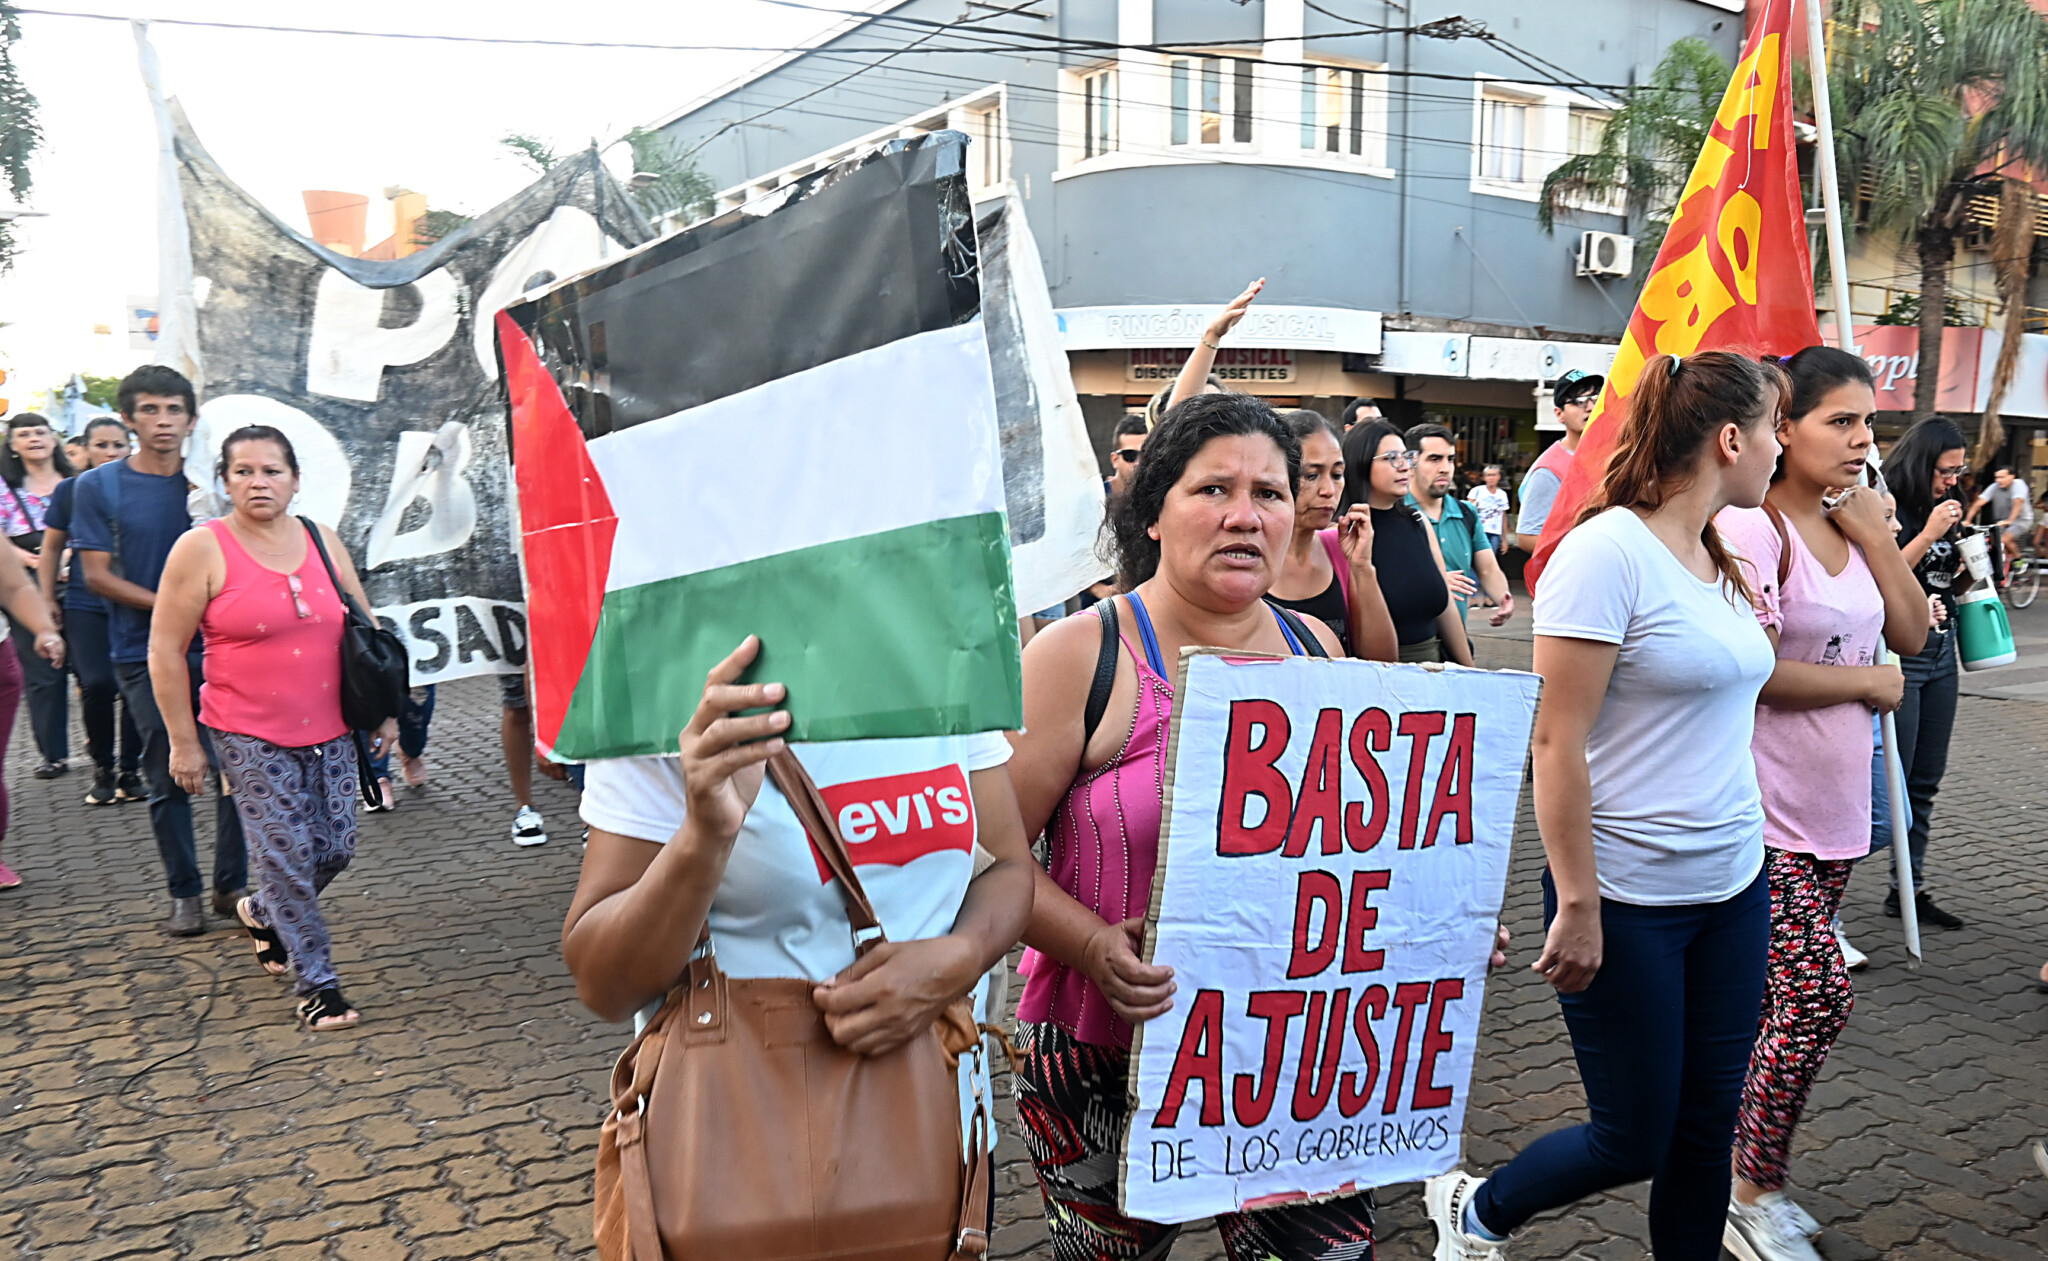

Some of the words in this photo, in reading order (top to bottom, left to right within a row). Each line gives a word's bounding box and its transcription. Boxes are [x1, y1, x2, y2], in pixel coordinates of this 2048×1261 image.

[1107, 309, 1204, 337] RINCÓN
[1233, 313, 1335, 339] USICAL
[1130, 350, 1194, 366] RINCO
[1216, 699, 1477, 858] BASTA
[838, 786, 969, 844] evi's
[1286, 869, 1391, 980] DE
[1151, 978, 1465, 1129] AJUSTE
[1151, 1138, 1198, 1183] DE
[1225, 1129, 1280, 1176] LOS
[1296, 1115, 1449, 1165] GOBIERNOS
